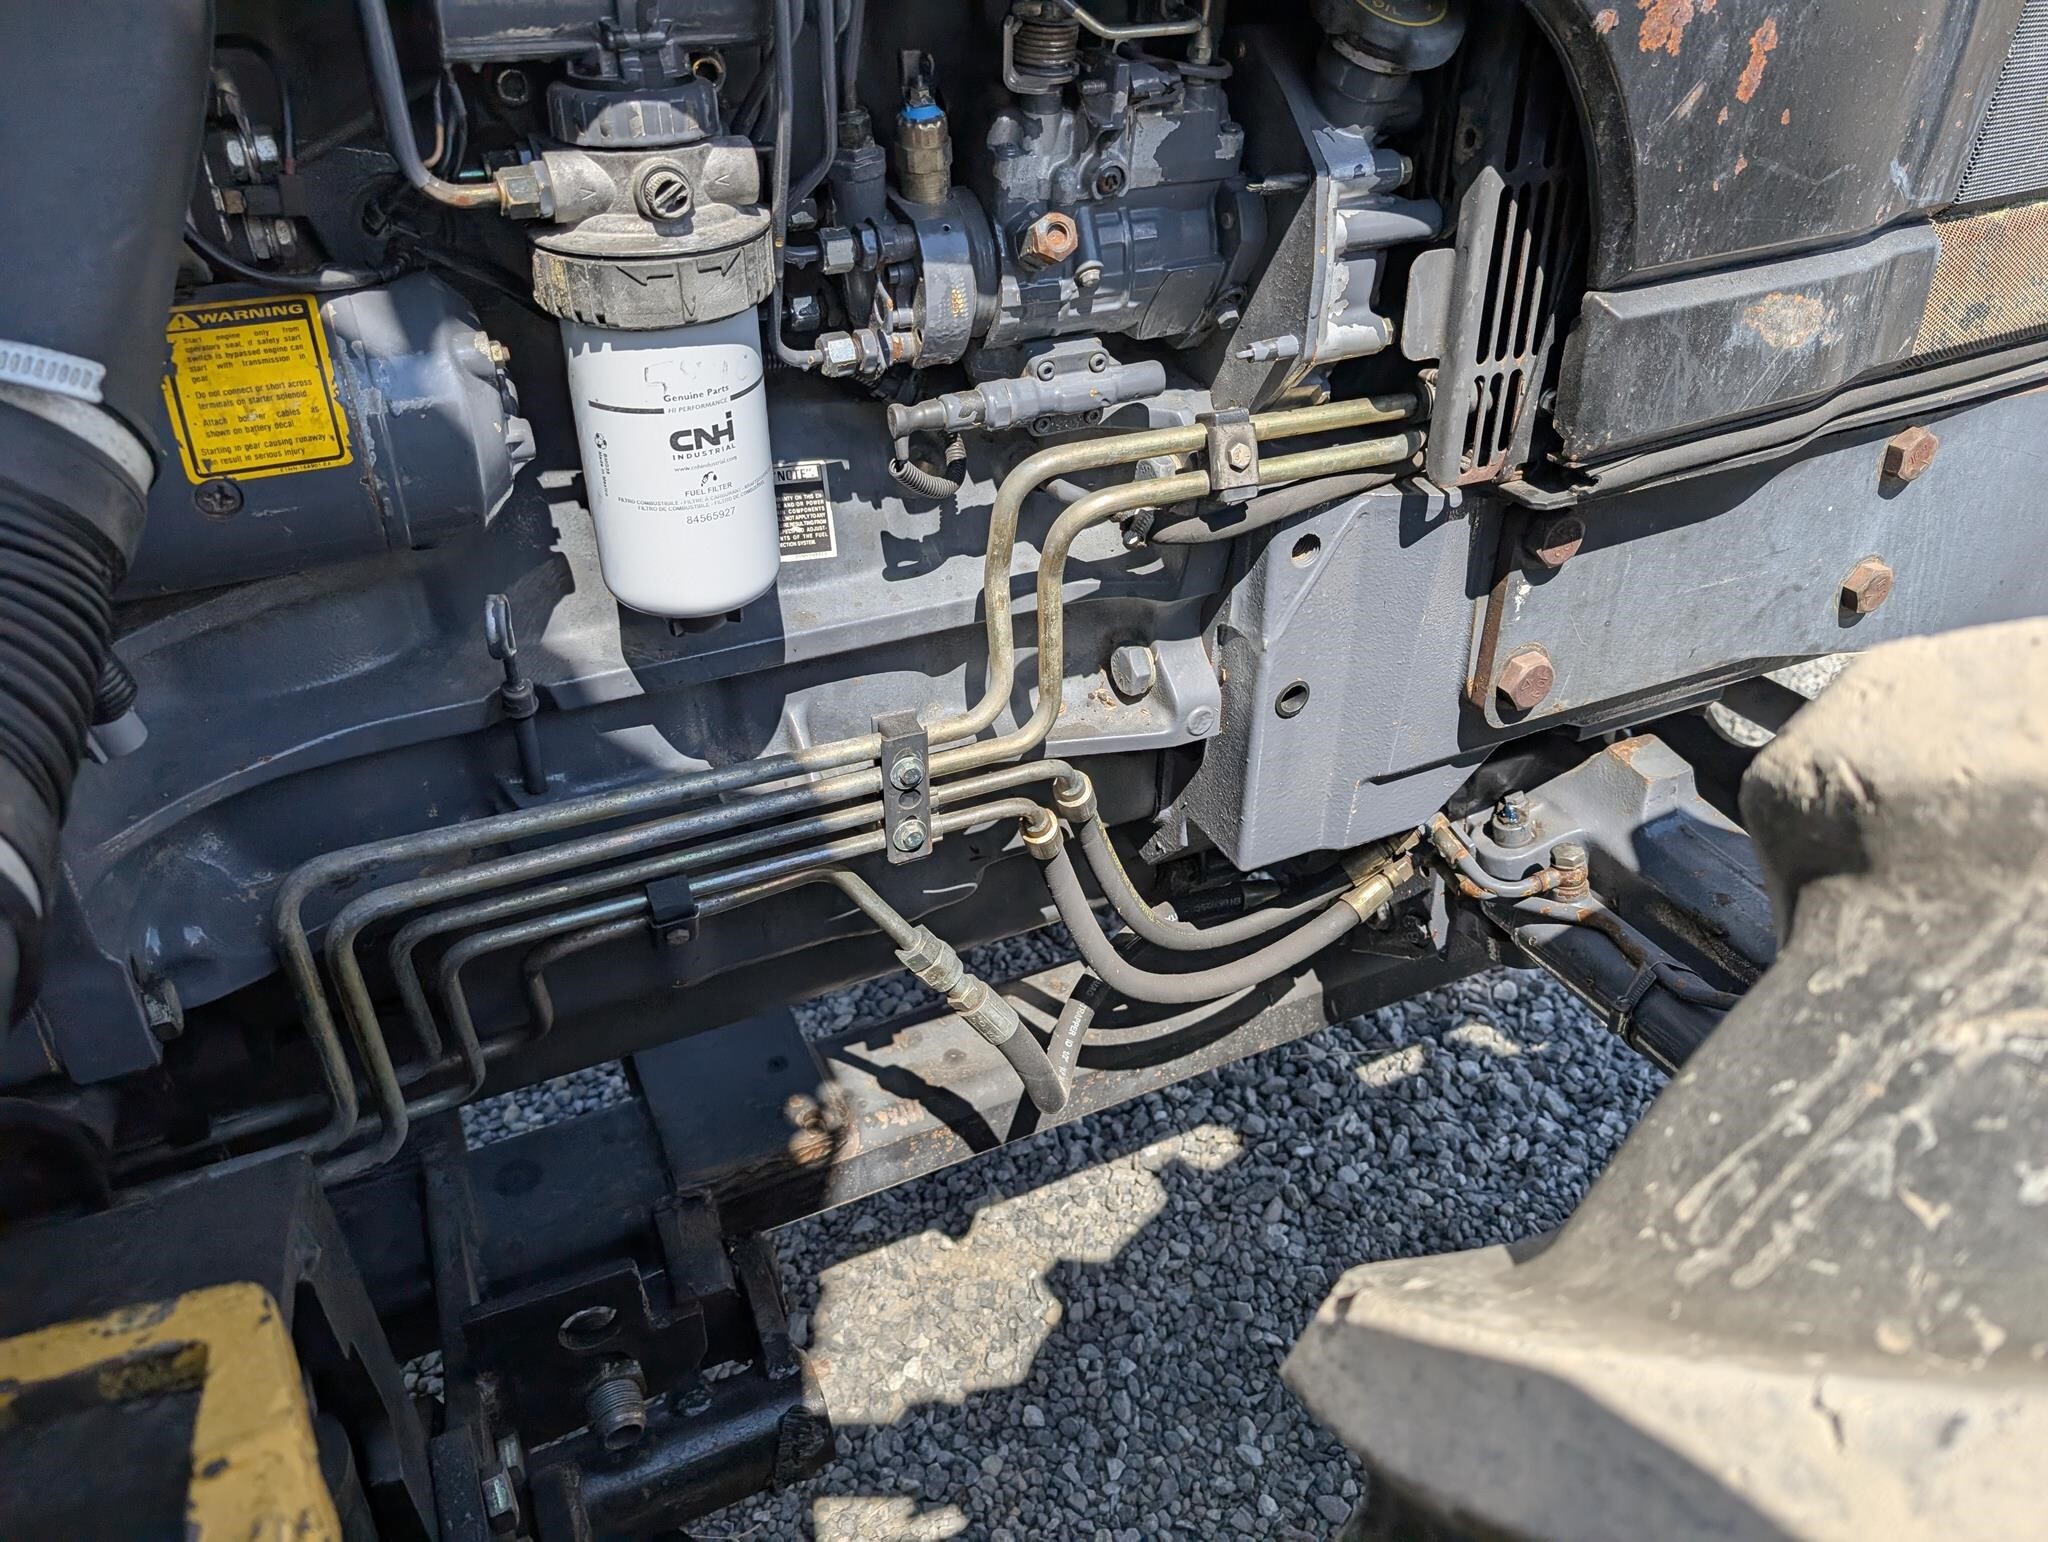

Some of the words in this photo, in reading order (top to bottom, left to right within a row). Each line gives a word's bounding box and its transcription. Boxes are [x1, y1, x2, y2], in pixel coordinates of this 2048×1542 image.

[197, 304, 304, 324] WARNING
[216, 333, 240, 341] engine
[254, 329, 270, 337] only
[257, 337, 280, 346] safety
[284, 334, 301, 342] start
[225, 348, 261, 359] bypassed
[263, 345, 288, 355] engine
[290, 344, 304, 352] can
[217, 362, 233, 370] with
[242, 355, 290, 367] transmission
[195, 391, 206, 399] Do
[209, 390, 220, 398] not
[223, 386, 253, 396] connect
[256, 385, 263, 393] or
[265, 382, 285, 391] short
[288, 378, 312, 388] across
[663, 391, 704, 403] Genuine
[707, 384, 729, 396] Parts
[198, 399, 234, 410] terminals
[236, 399, 246, 408] on
[248, 395, 273, 405] starter
[276, 390, 308, 400] solenoid
[668, 406, 677, 414] HI
[678, 398, 729, 413] PERFORMANCE
[203, 416, 228, 427] Attach
[276, 408, 301, 418] cables
[206, 429, 232, 439] shown
[233, 427, 243, 435] on
[245, 422, 272, 435] battery
[200, 444, 232, 457] Starting
[244, 442, 261, 452] gear
[263, 437, 294, 448] causing
[295, 433, 326, 445] runaway
[672, 443, 737, 461] INDUSTRIAL
[220, 452, 243, 464] result
[254, 450, 282, 460] serious
[284, 446, 306, 457] injury
[674, 455, 738, 473] www.cnhindustrial.com
[685, 489, 706, 497] FUEL
[708, 481, 733, 493] FILTER
[618, 496, 636, 504] FILTRO
[686, 506, 736, 525] 84565927
[788, 506, 825, 514] COMPONENTS
